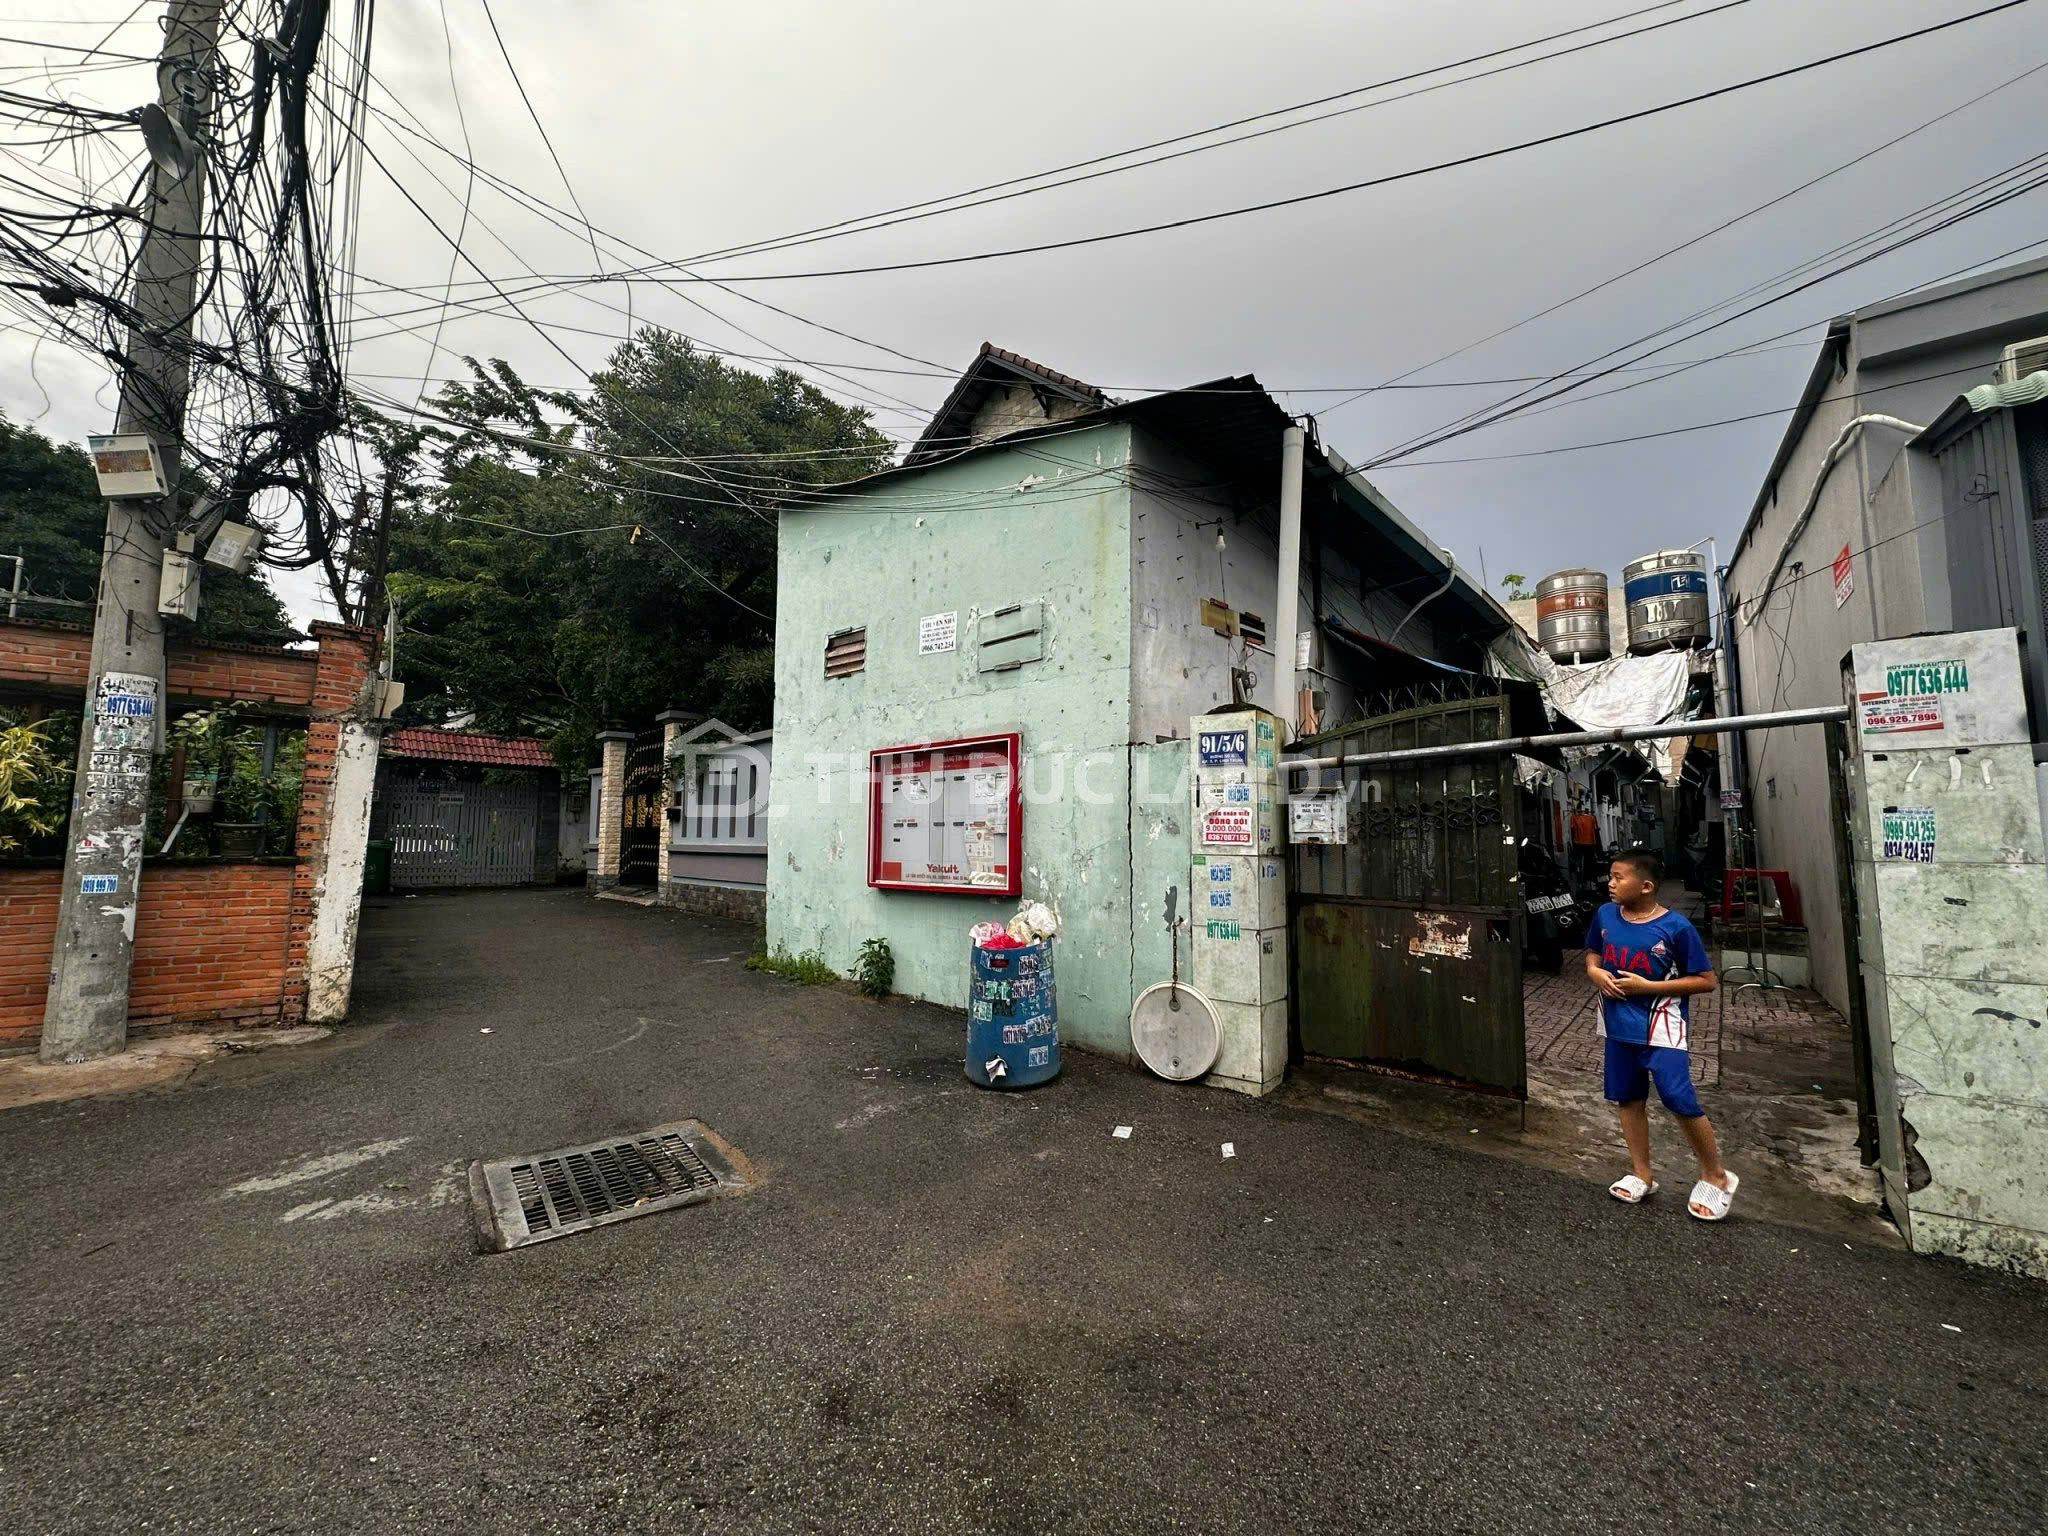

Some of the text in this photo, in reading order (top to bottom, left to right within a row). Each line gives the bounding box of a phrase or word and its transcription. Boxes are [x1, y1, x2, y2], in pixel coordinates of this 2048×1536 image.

[1887, 668, 1968, 696] 0977.636.444
[1867, 713, 1938, 725] 096.926.7896
[1201, 734, 1244, 753] 91/5/6
[926, 864, 960, 874] Yakult
[1602, 943, 1652, 976] AIA
